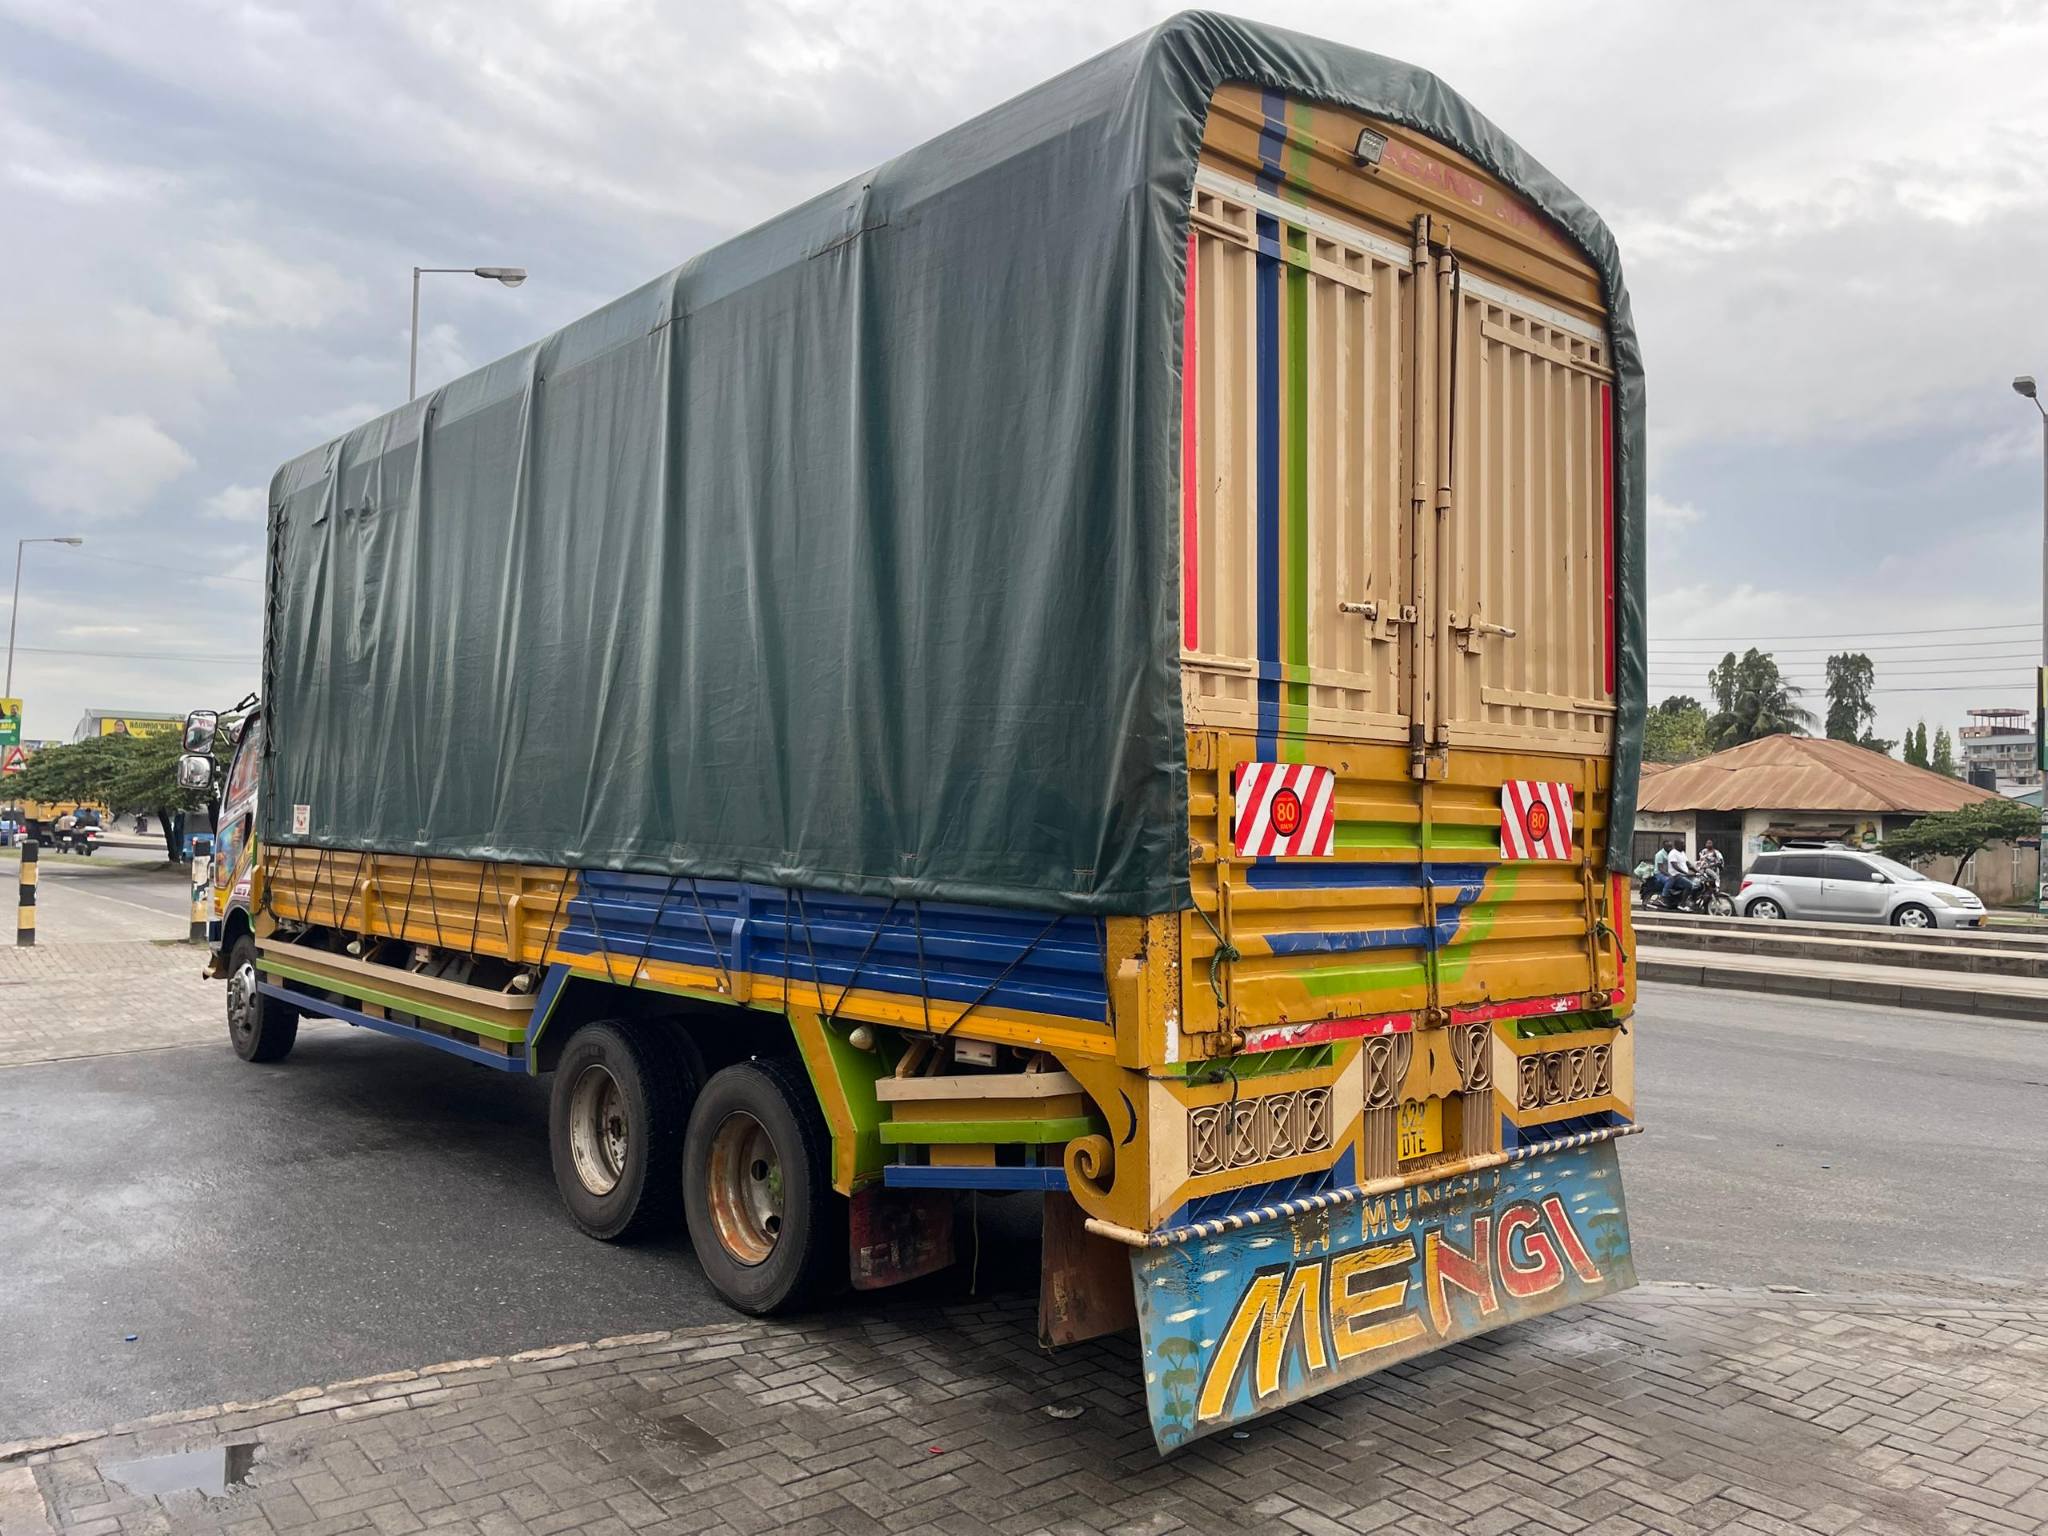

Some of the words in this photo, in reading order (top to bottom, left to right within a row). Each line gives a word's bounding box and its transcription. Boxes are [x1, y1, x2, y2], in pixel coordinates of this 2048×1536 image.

[1277, 803, 1294, 821] 80
[1532, 812, 1545, 829] 80
[1196, 1195, 1604, 1421] MENGI
